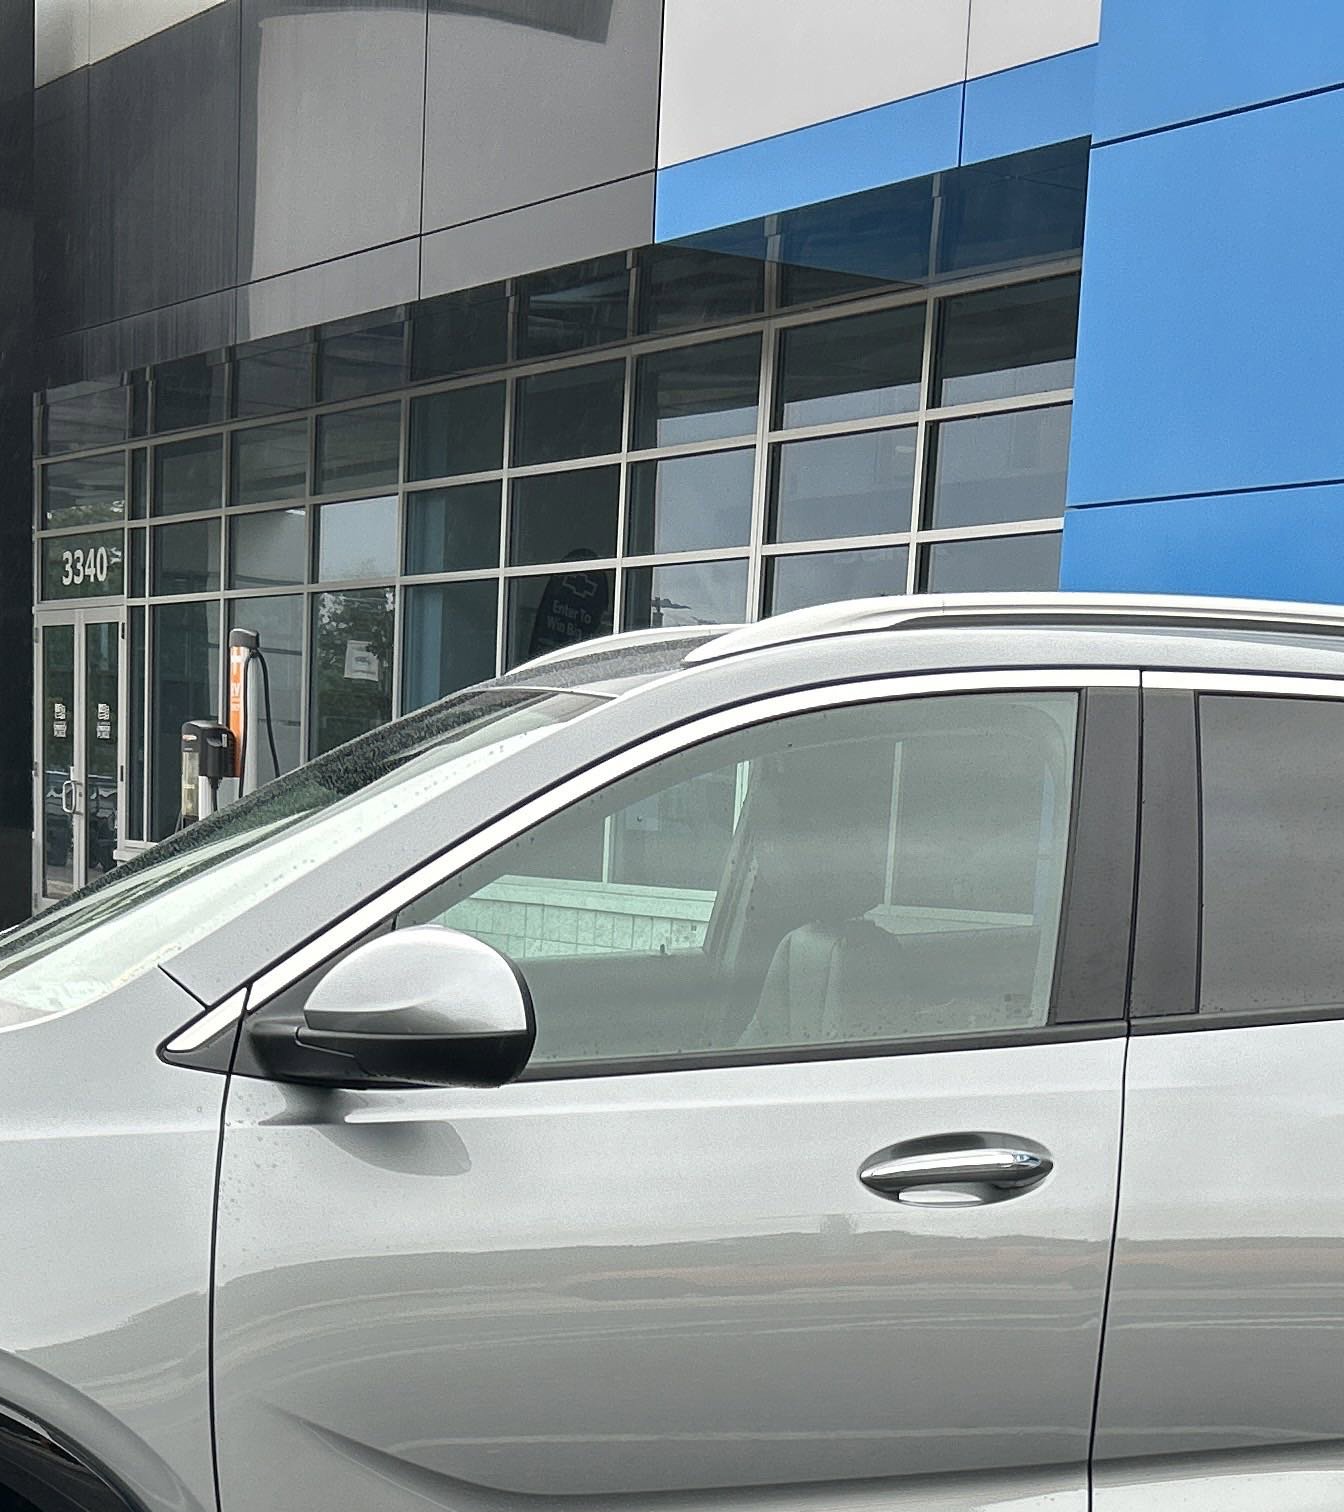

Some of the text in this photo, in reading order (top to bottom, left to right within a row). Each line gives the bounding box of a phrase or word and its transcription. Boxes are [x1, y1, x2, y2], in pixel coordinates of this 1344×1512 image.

[62, 546, 108, 586] 3340
[546, 615, 566, 634] Win
[552, 599, 593, 625] Enter To
